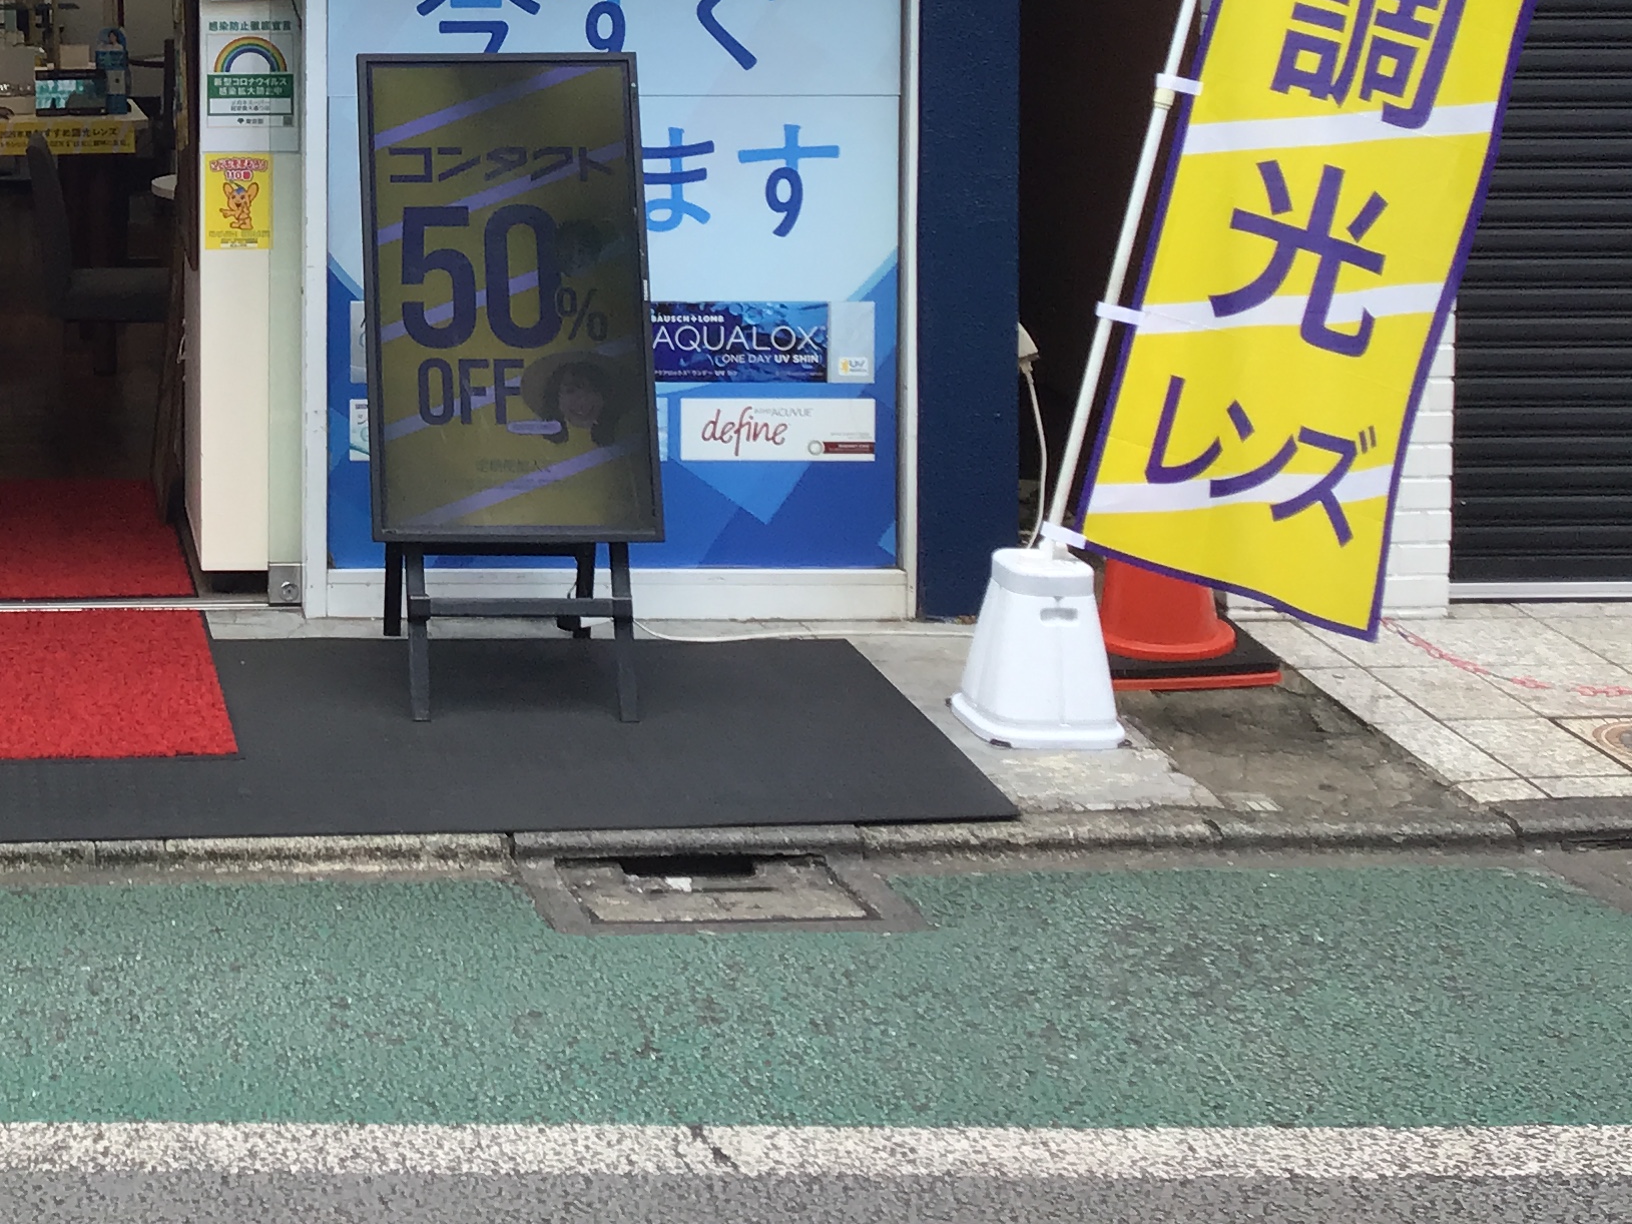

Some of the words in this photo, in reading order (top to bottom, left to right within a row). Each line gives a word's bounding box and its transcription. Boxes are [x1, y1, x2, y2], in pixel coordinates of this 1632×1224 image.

[388, 146, 613, 184] コンタクト
[653, 326, 820, 351] AQUALOX
[774, 354, 789, 364] UV
[418, 358, 525, 426] OFF
[701, 406, 788, 456] define
[1144, 375, 1378, 547] レンズ
